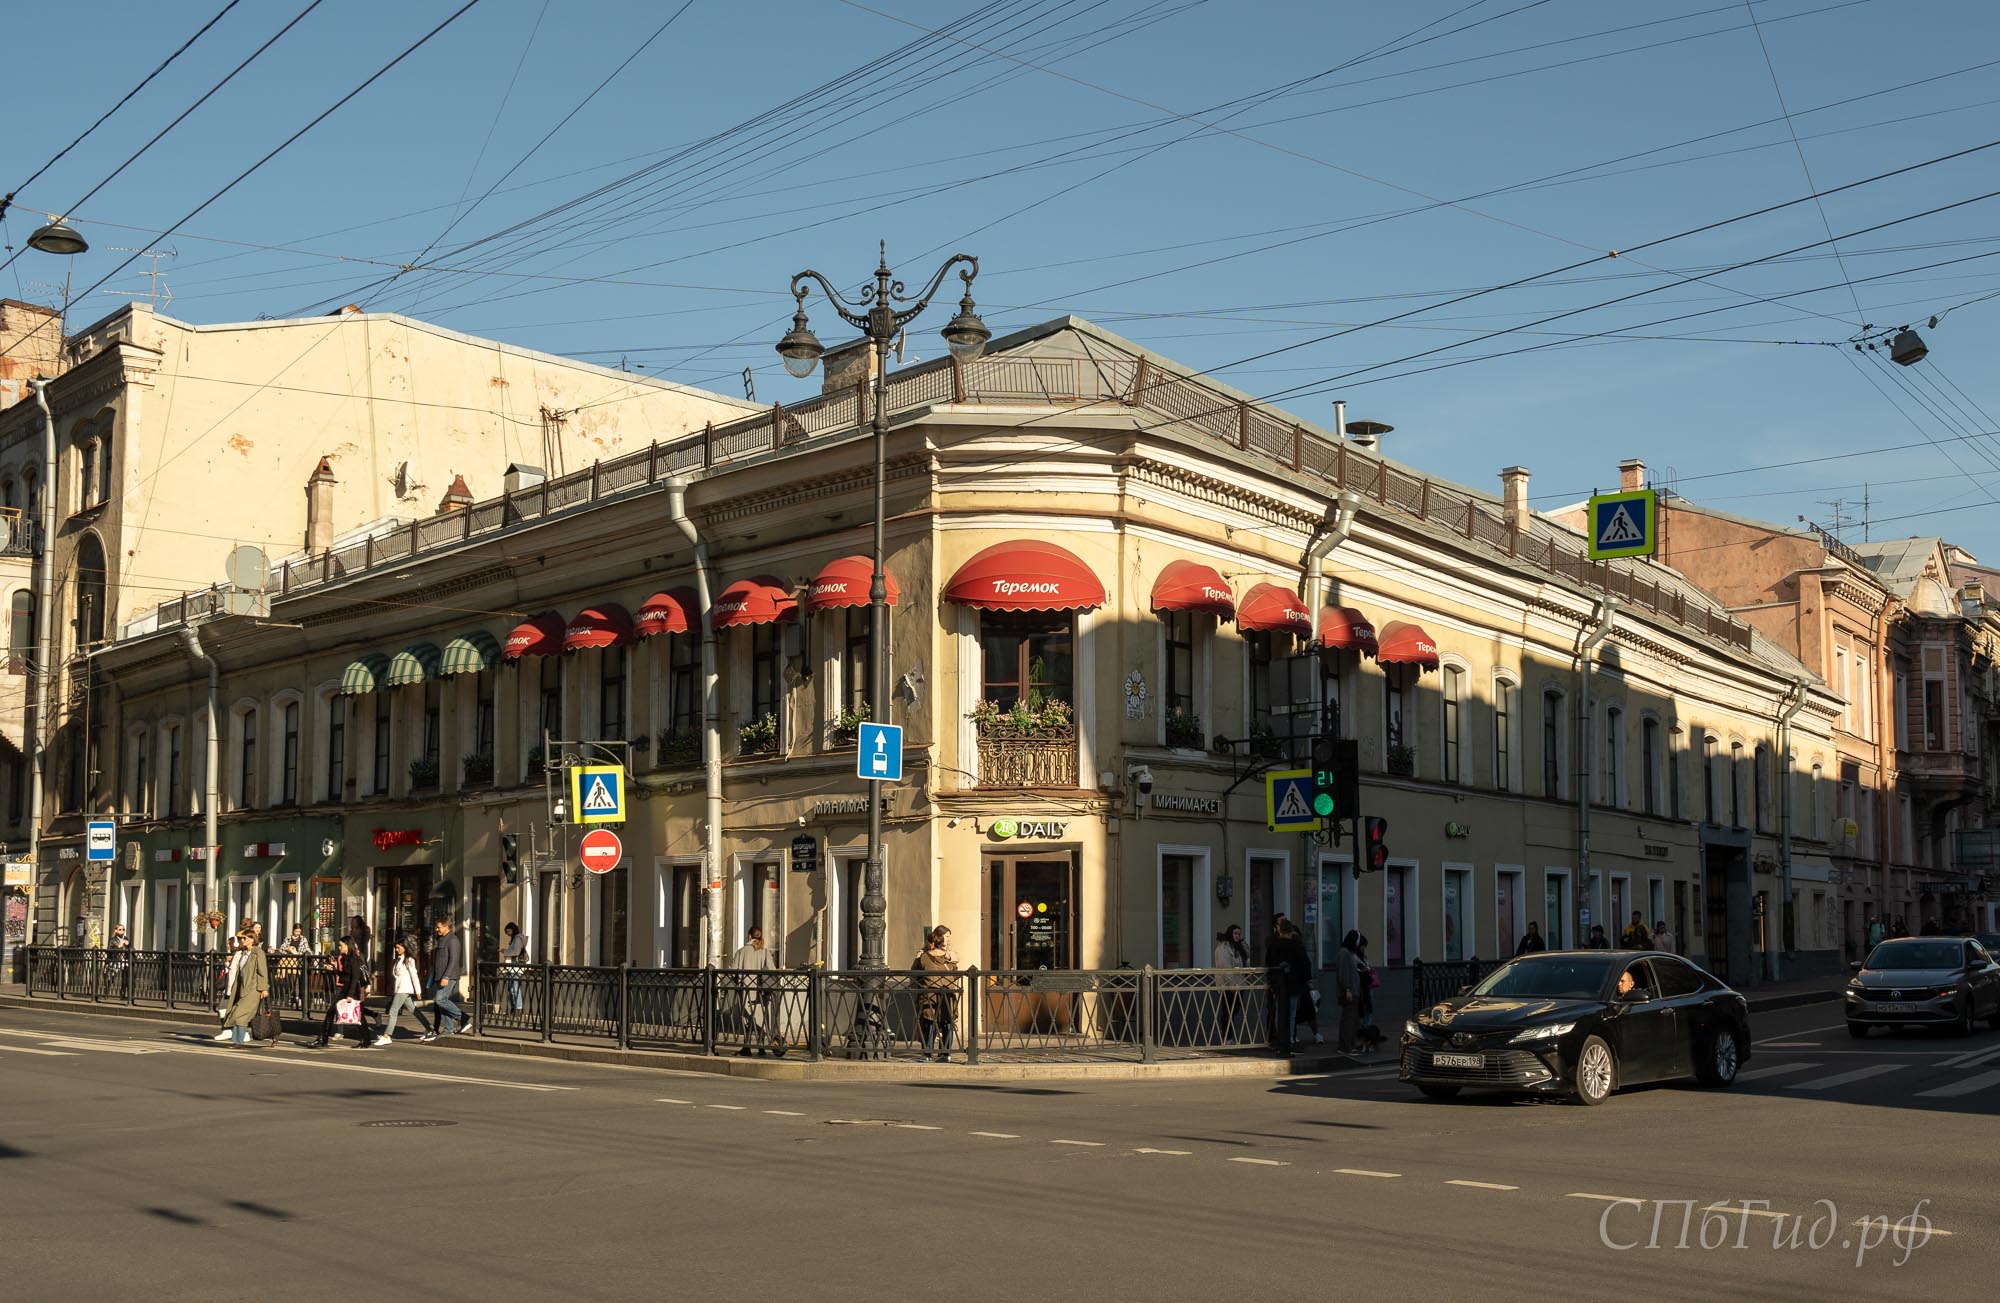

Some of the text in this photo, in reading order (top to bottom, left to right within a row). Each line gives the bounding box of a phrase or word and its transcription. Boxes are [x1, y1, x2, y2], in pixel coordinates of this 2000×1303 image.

[992, 579, 1060, 596] Теремок
[1317, 771, 1334, 786] 21
[1156, 794, 1222, 813] МИНИМАРКЕТ
[1020, 822, 1071, 836] DAILY
